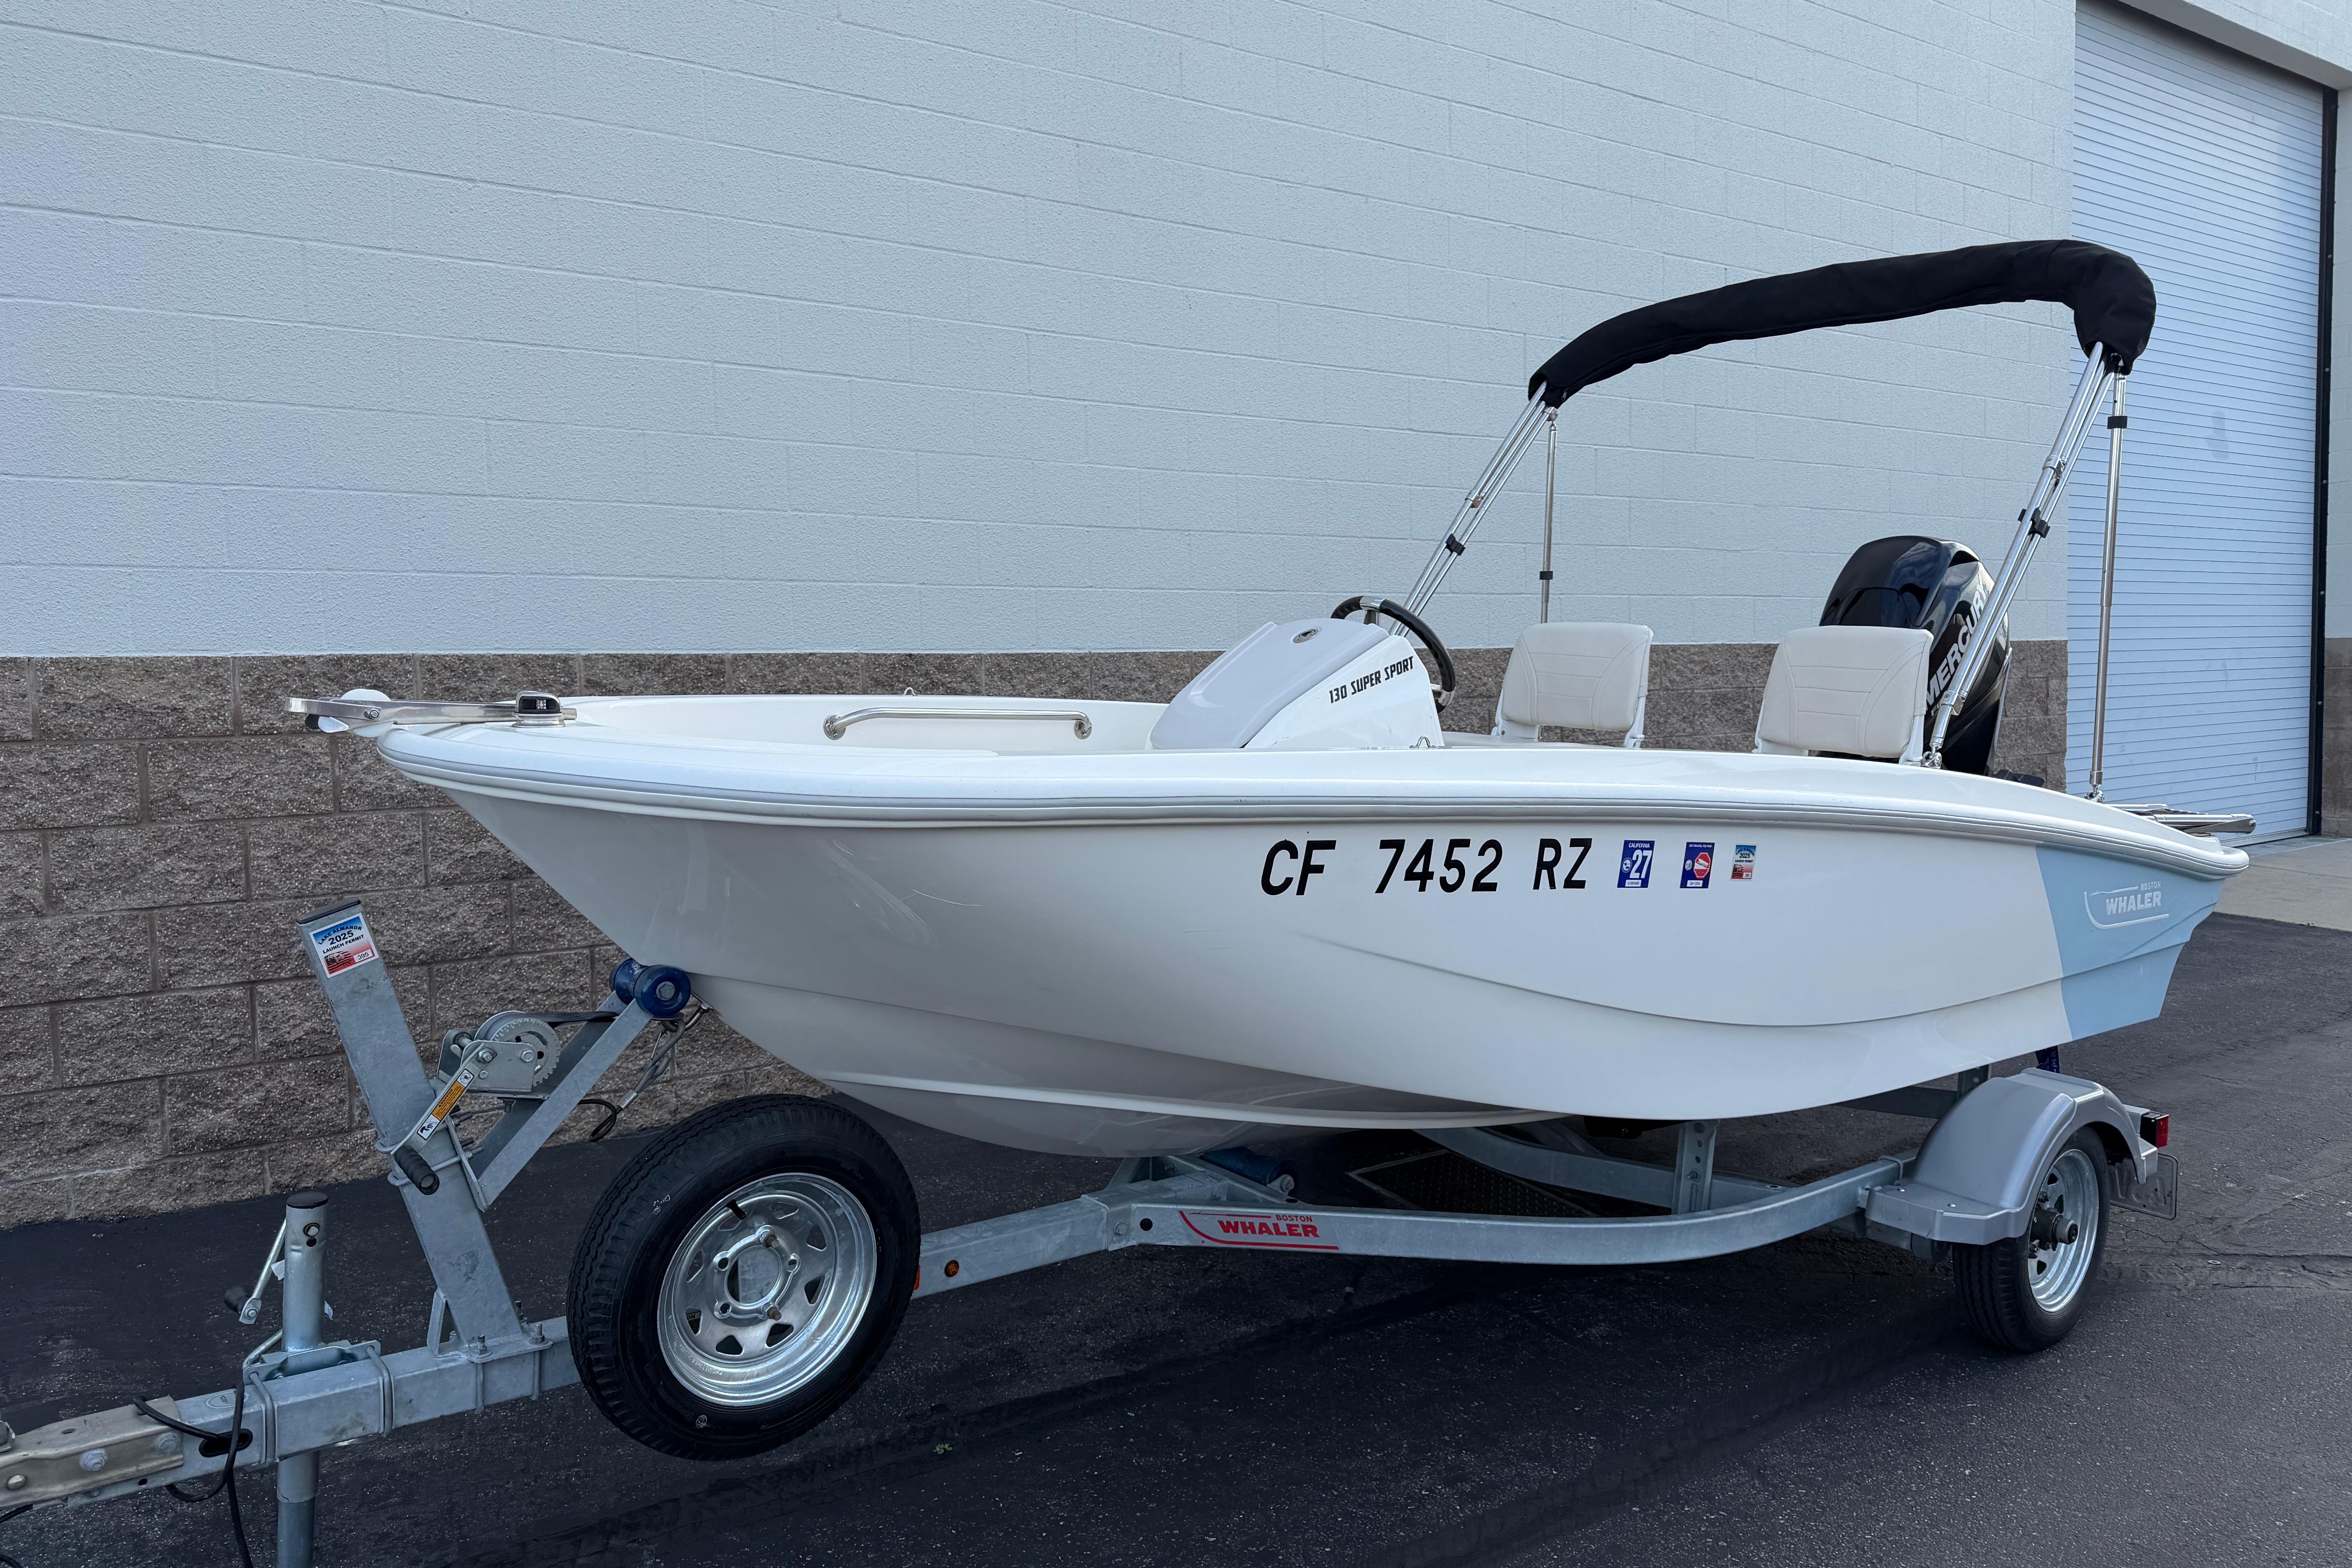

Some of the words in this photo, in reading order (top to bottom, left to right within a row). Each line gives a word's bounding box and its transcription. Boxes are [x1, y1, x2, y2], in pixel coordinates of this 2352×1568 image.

[1926, 574, 1988, 711] MERCURY
[1329, 685, 1347, 704] 130
[1350, 670, 1381, 695] SUPER
[1384, 656, 1414, 681] SPORT
[1260, 838, 1336, 896] CF
[1374, 838, 1503, 893] 7452
[1533, 838, 1593, 890] RZ
[1629, 849, 1652, 878] 27
[2141, 881, 2161, 891] BOSTON
[2105, 891, 2161, 916] WHALER
[318, 932, 331, 945] LAKE
[322, 943, 345, 954] LAUNCH
[345, 934, 364, 945] PERMIT
[329, 930, 354, 945] 2025
[1275, 1214, 1313, 1223] BOSTON
[1218, 1220, 1320, 1238] WHALER
